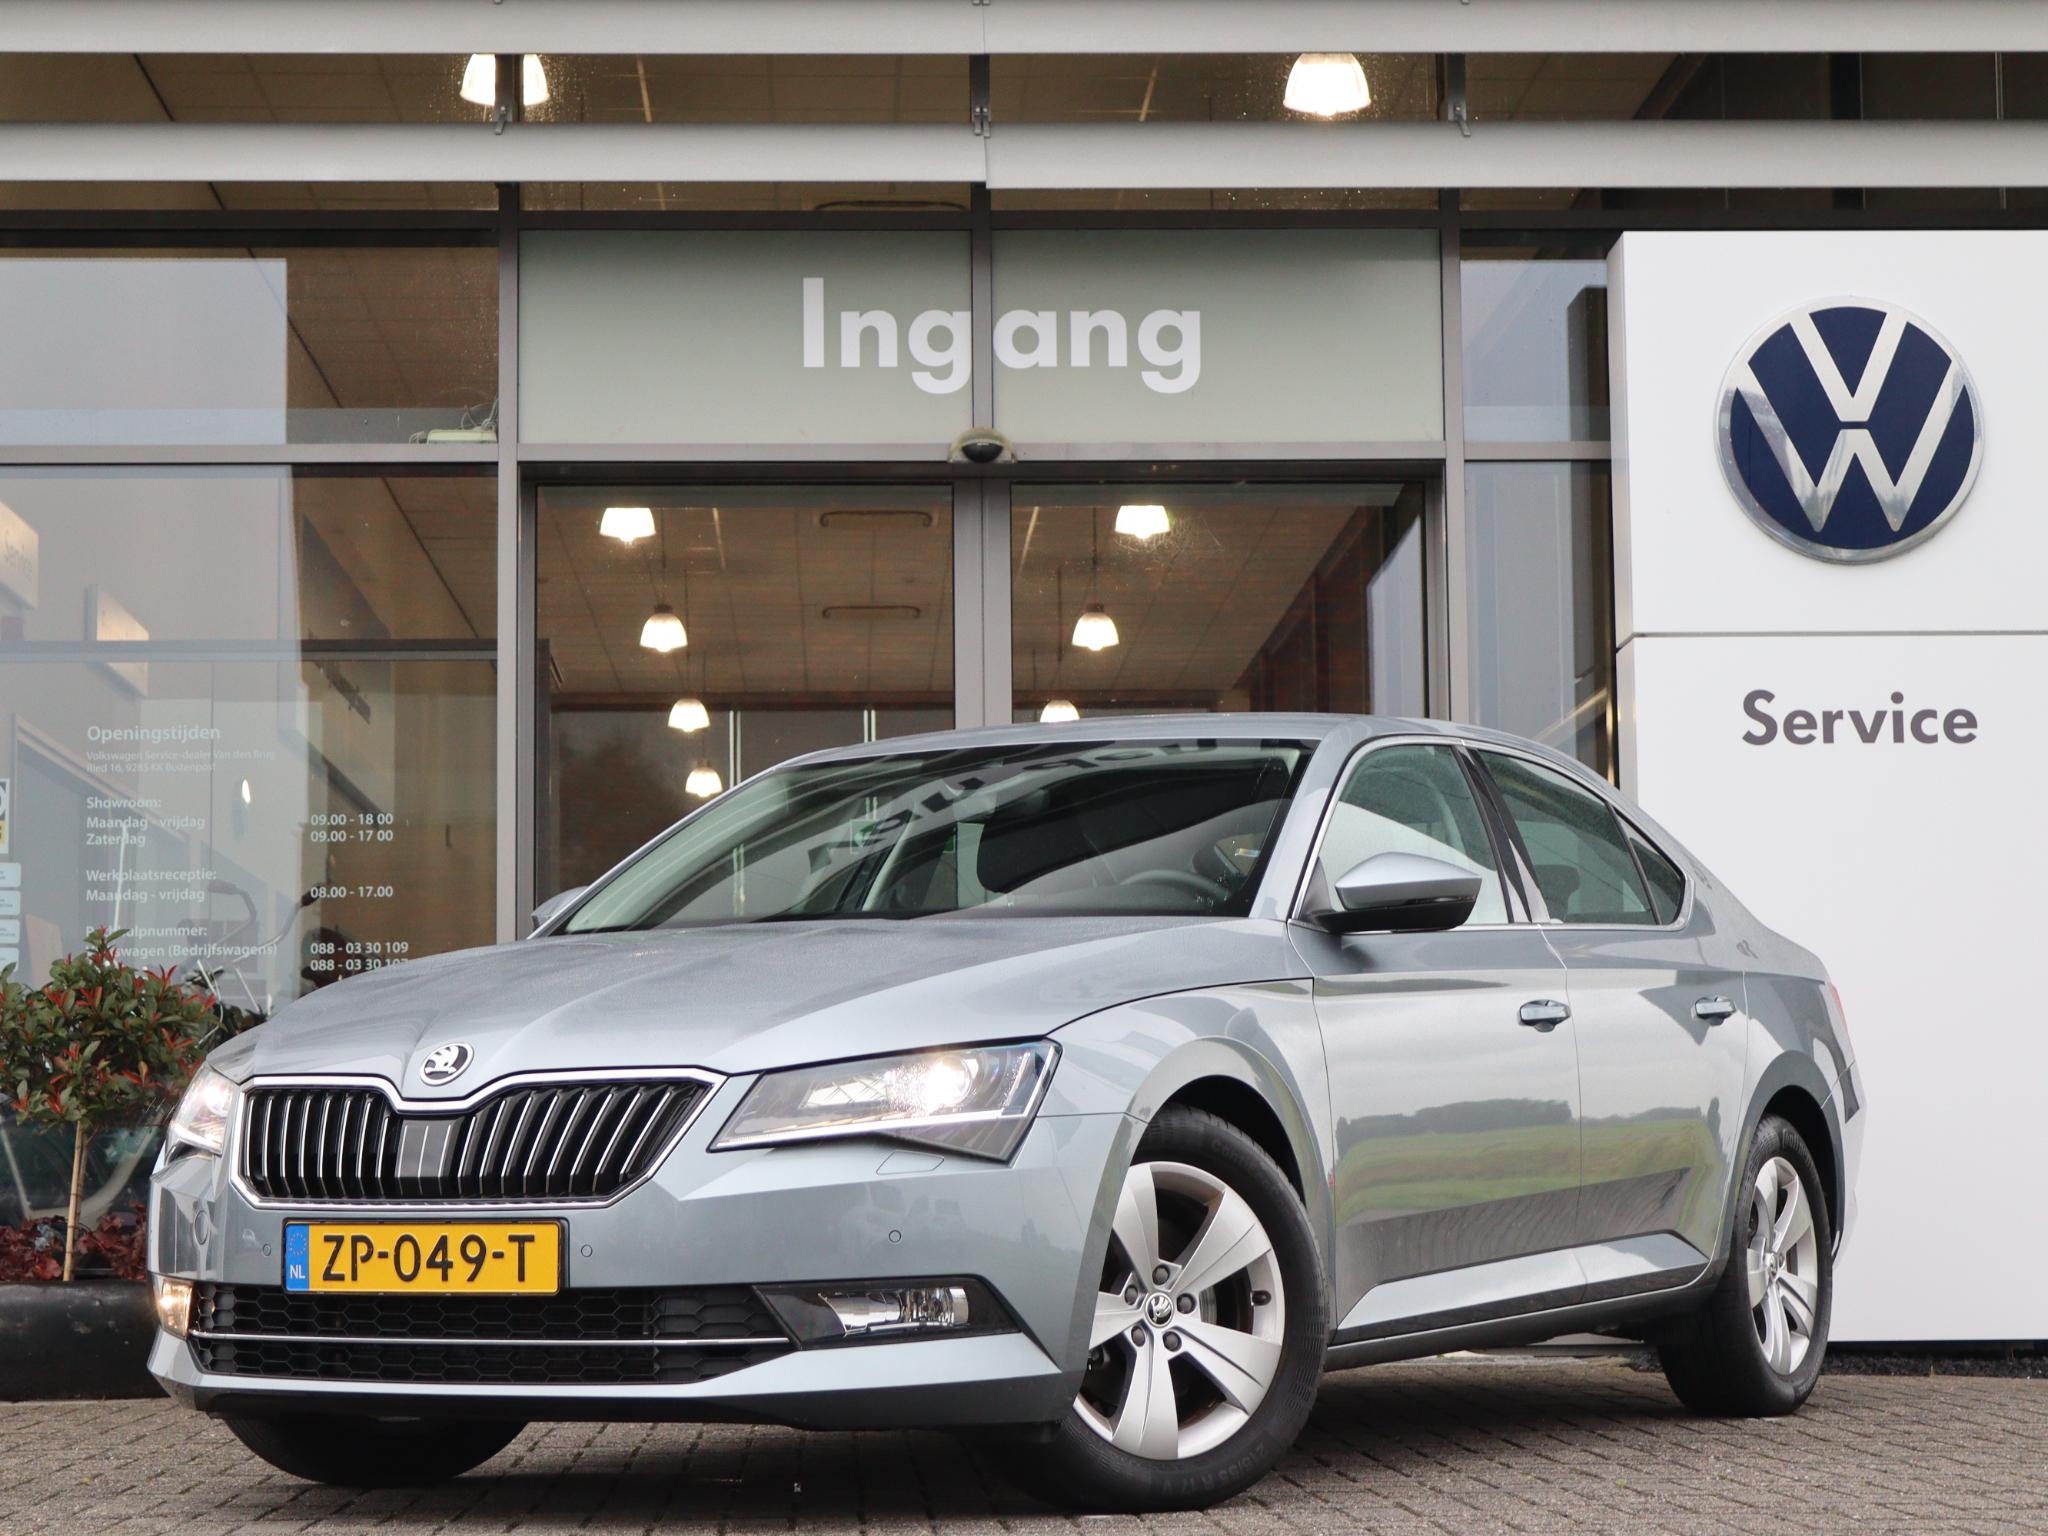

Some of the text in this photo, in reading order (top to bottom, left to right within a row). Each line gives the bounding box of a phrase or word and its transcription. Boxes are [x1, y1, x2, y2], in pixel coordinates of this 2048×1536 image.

[803, 277, 1201, 394] Ingang
[1741, 689, 1978, 746] Service
[87, 725, 221, 744] Openingstijden
[86, 751, 142, 762] Volkswagen
[86, 796, 162, 809] Showroom:
[86, 815, 148, 831] Maandag
[159, 815, 206, 831] vrijdag
[310, 813, 347, 826] 09.00
[86, 833, 146, 848] Zaterdag
[310, 830, 347, 843] 09.00
[86, 889, 148, 904] Maandag
[159, 888, 206, 904] vrijdag
[310, 886, 347, 898] 08.00
[358, 885, 394, 898] 17.00
[168, 943, 278, 959] (Bedrijfswagens)
[310, 942, 335, 954] 088
[345, 942, 362, 954] 03
[365, 942, 381, 954] 30
[385, 941, 409, 953] 109
[310, 959, 335, 971] 088
[345, 959, 362, 970] 03
[365, 958, 381, 970] 30
[322, 1234, 535, 1282] ZP-049-T
[289, 1265, 306, 1279] NL
